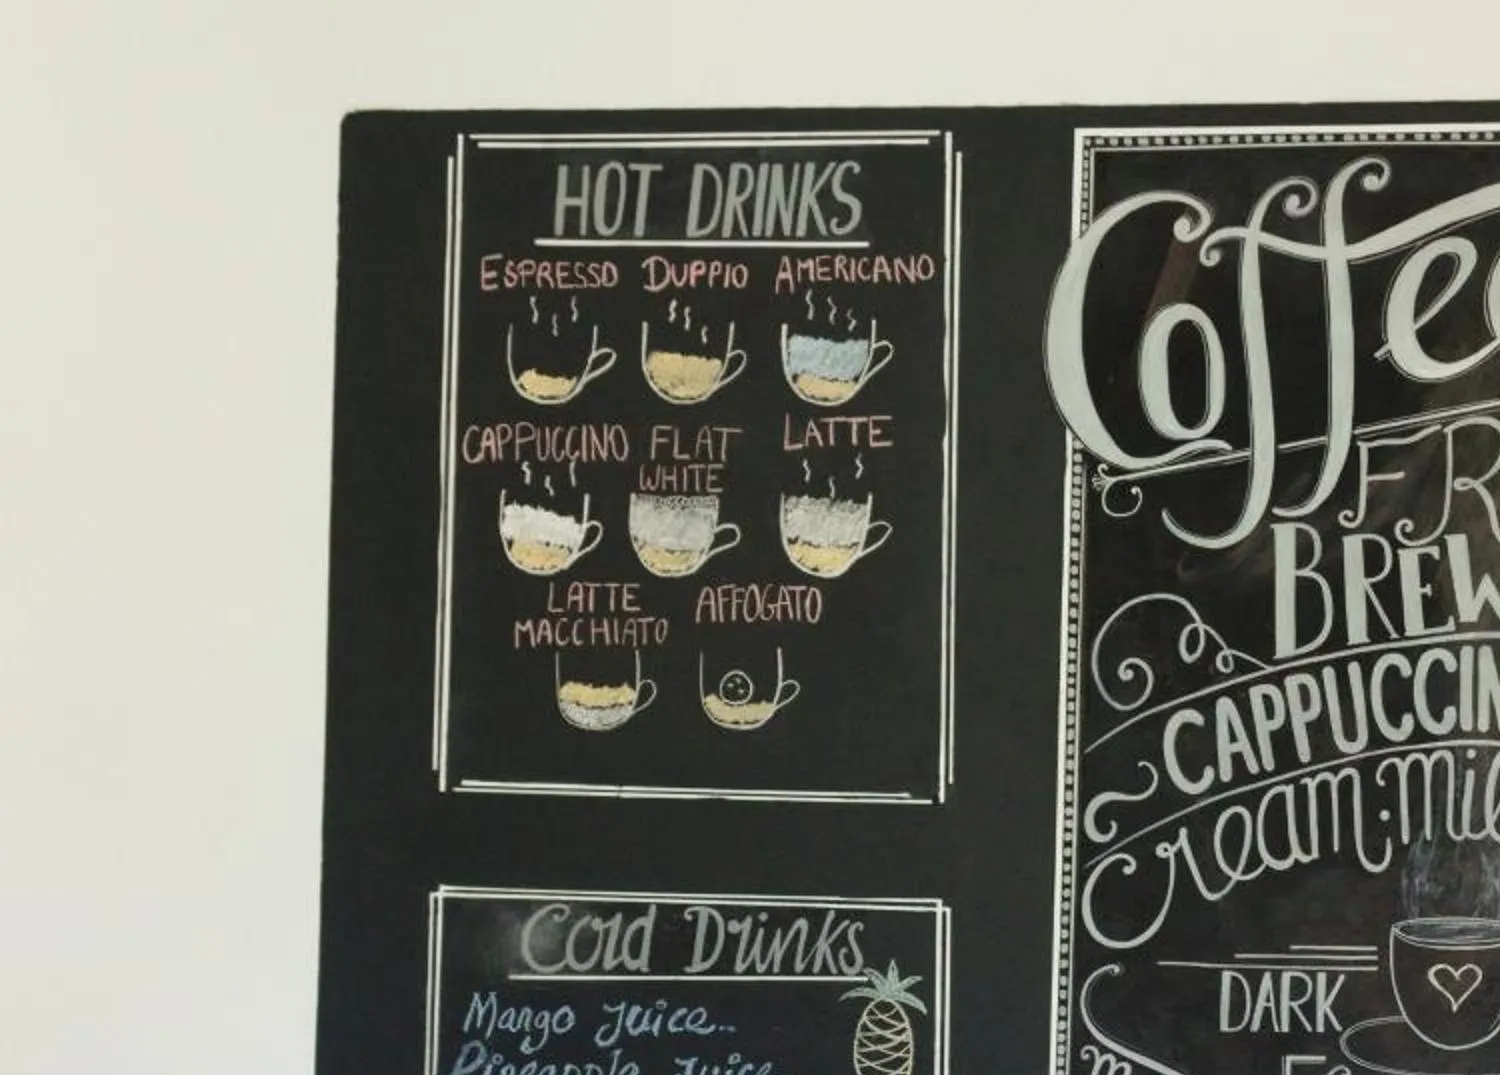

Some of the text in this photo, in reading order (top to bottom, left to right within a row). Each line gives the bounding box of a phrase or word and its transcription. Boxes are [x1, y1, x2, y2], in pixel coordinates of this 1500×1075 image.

[553, 160, 863, 238] HOT DRINKS
[480, 254, 619, 291] ESPRESSO
[642, 255, 748, 292] DUPPIO
[775, 254, 934, 294] AMERICANO
[462, 422, 629, 464] CAPPUCCINO
[650, 425, 744, 461] FLAT
[784, 412, 894, 451] LATTE
[639, 464, 724, 493] WHITE
[546, 582, 640, 614] LATTE
[695, 583, 822, 625] AFFOGATO
[514, 617, 669, 650] MACCHIATO
[683, 905, 866, 976] Drinks
[1220, 971, 1345, 1034] DARK
[463, 991, 576, 1055] Mango
